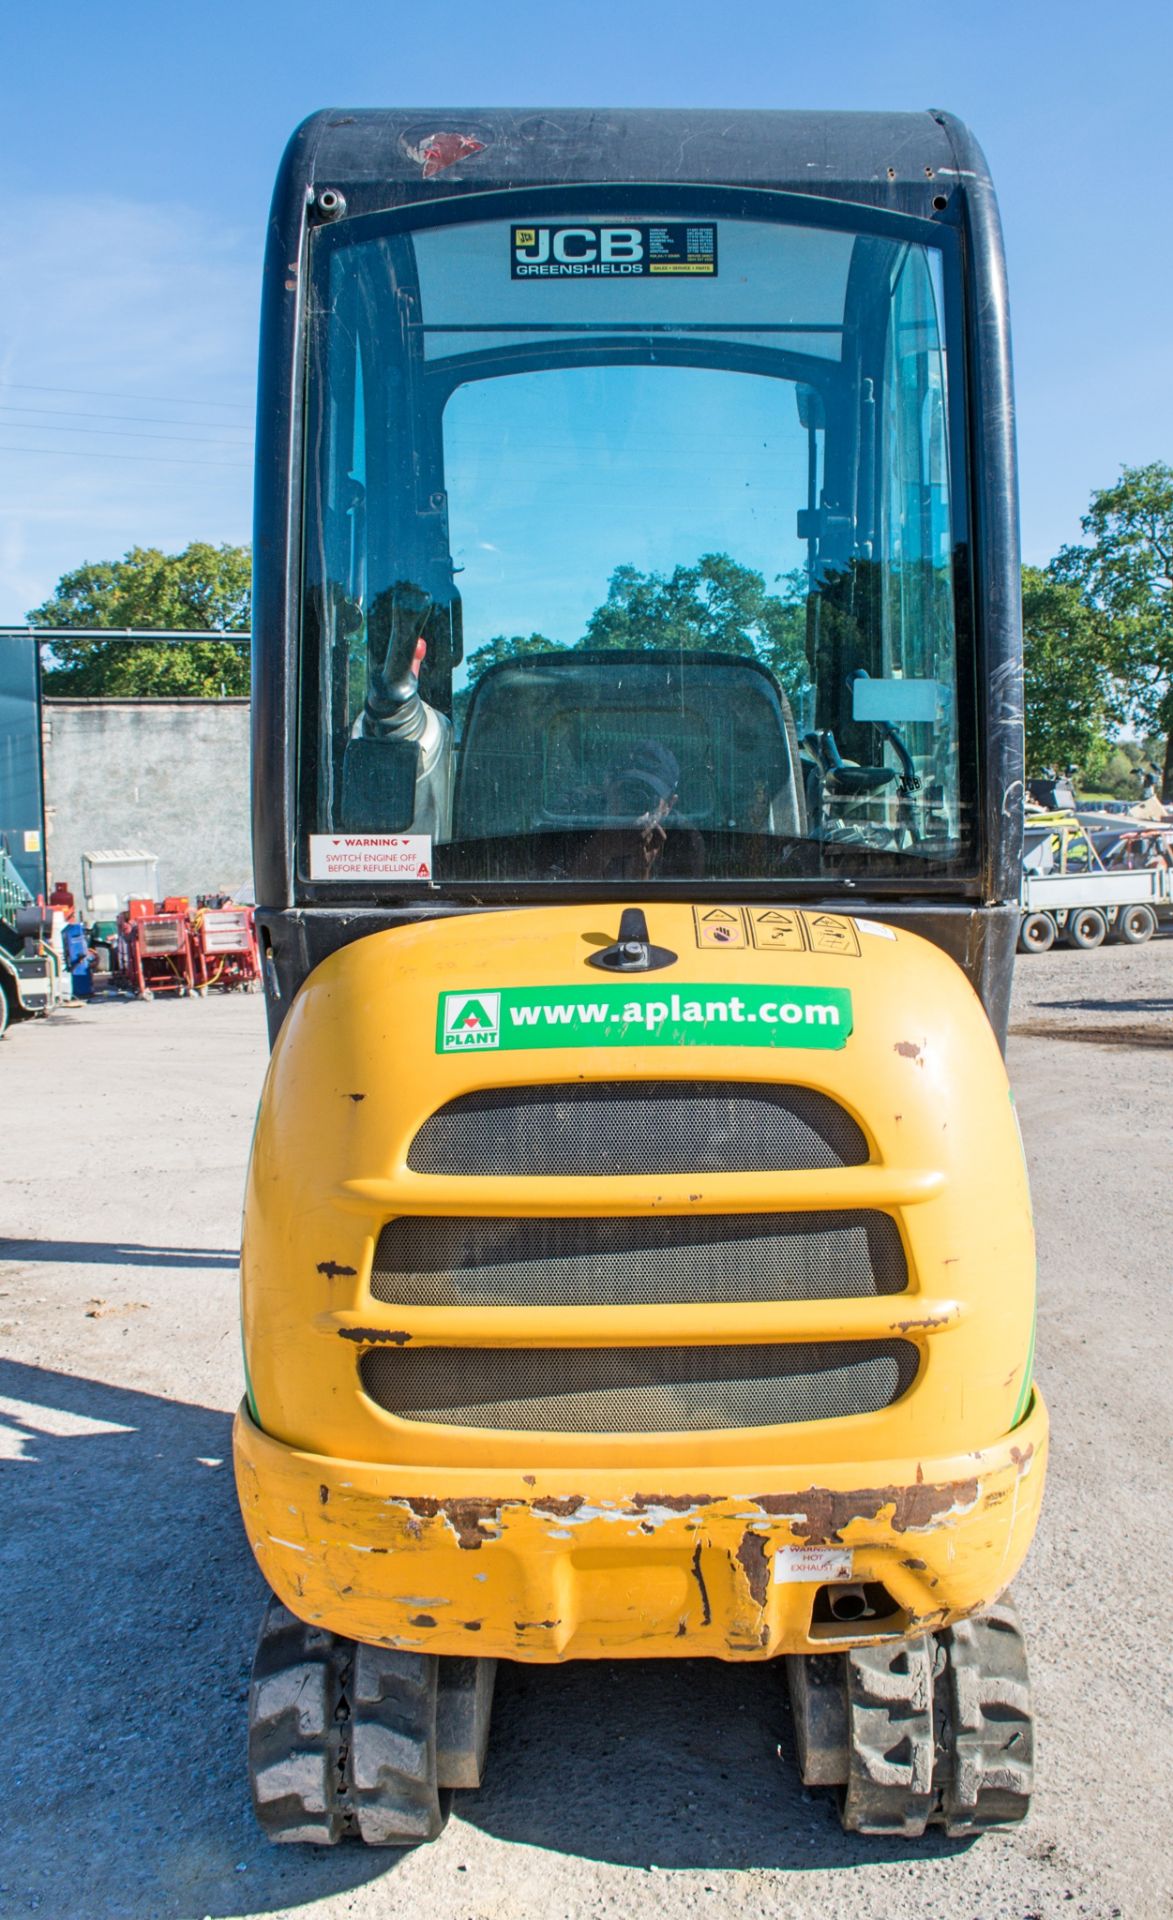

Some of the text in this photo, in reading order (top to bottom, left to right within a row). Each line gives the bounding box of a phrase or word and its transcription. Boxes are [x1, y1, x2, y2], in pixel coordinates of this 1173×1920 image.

[515, 228, 644, 264] JCB
[516, 264, 643, 275] GREENSHIELDS
[345, 838, 398, 847] WARNING
[326, 853, 417, 862] SWITCH ENGINE OFF
[328, 863, 415, 872] BEFORE REFUELLING
[510, 995, 840, 1030] www.aplant.com
[445, 1032, 498, 1046] PLANT
[791, 1564, 832, 1572] EXHAUST
